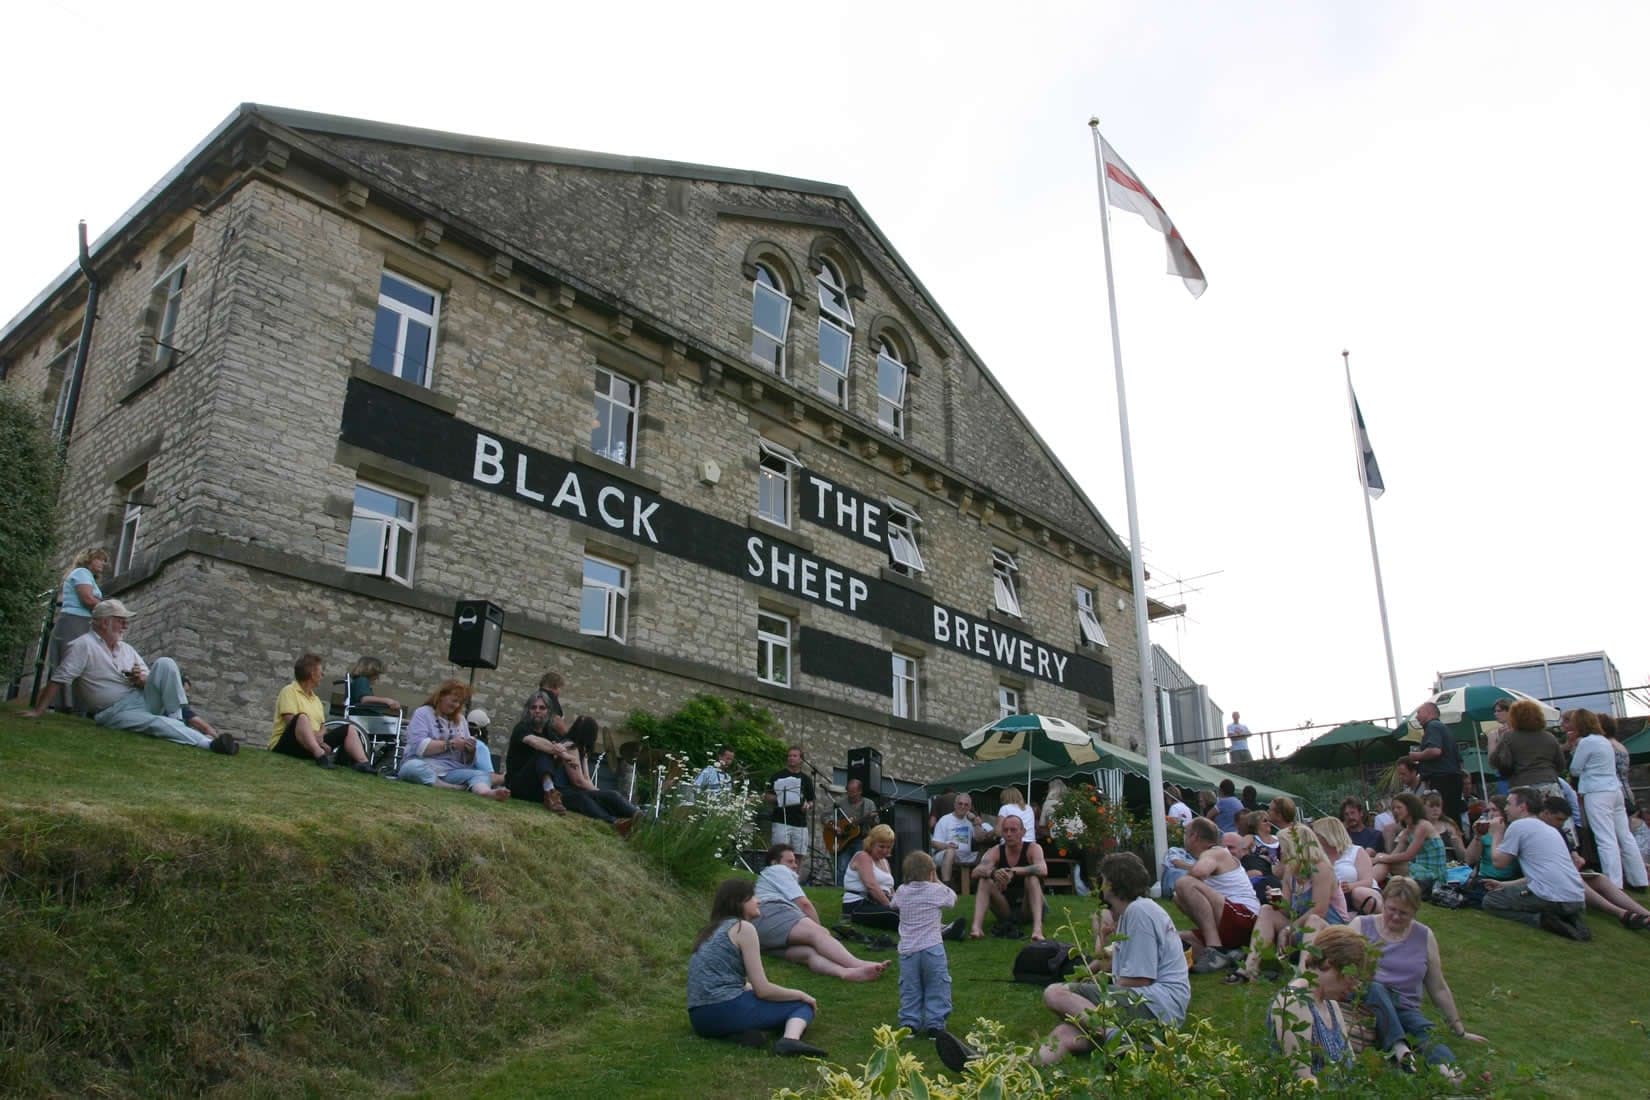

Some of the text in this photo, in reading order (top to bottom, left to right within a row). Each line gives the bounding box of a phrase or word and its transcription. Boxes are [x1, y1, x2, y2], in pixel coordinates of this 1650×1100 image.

[473, 433, 1068, 683] BLACK SHEEP BREWERY
[810, 476, 881, 542] THE
